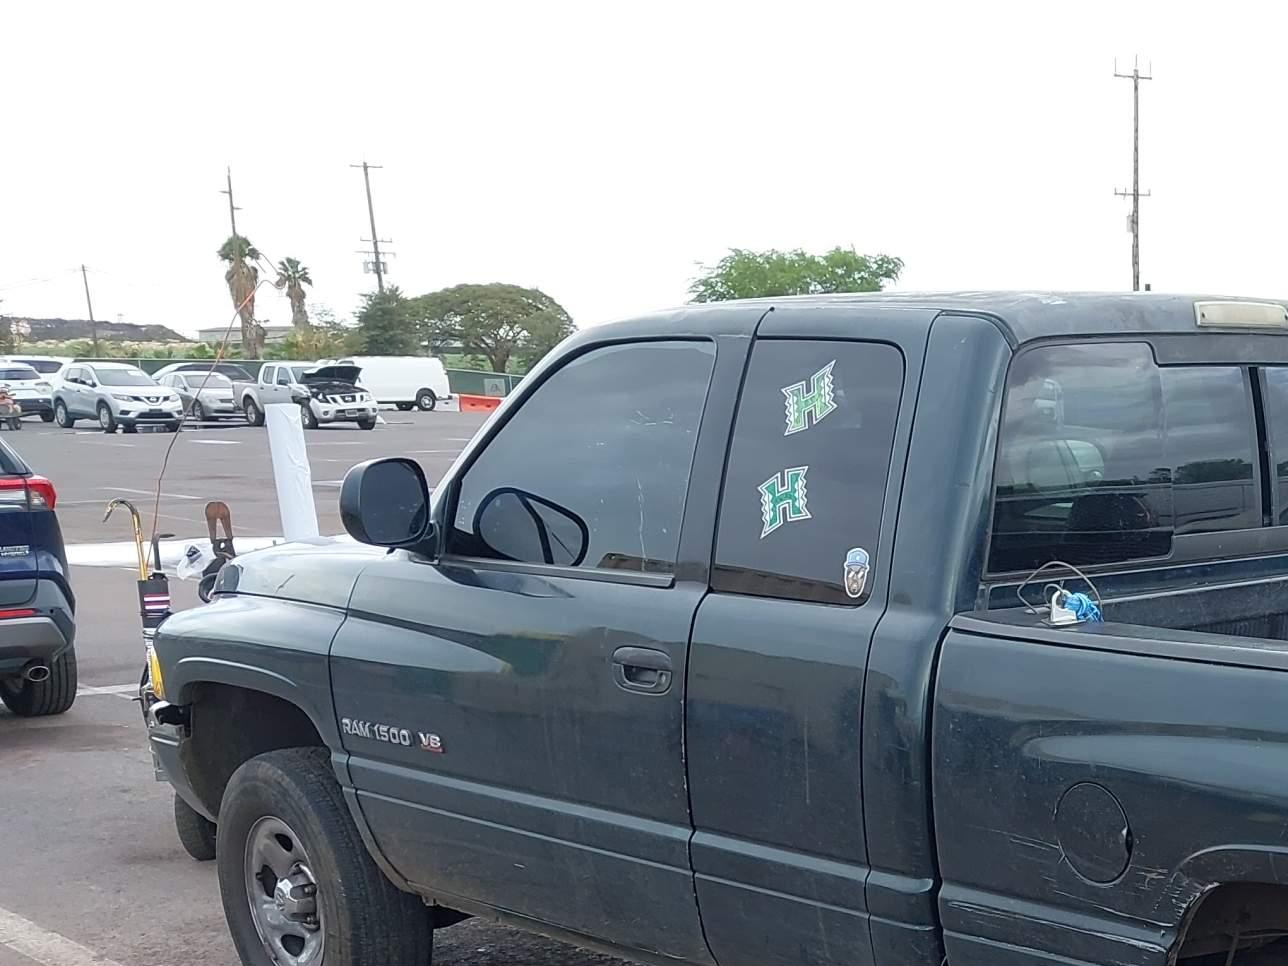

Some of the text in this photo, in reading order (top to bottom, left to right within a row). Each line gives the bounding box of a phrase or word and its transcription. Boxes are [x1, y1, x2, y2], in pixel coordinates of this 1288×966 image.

[781, 360, 838, 437] H
[757, 466, 812, 540] H
[341, 718, 370, 738] RAM
[373, 723, 411, 746] 1500
